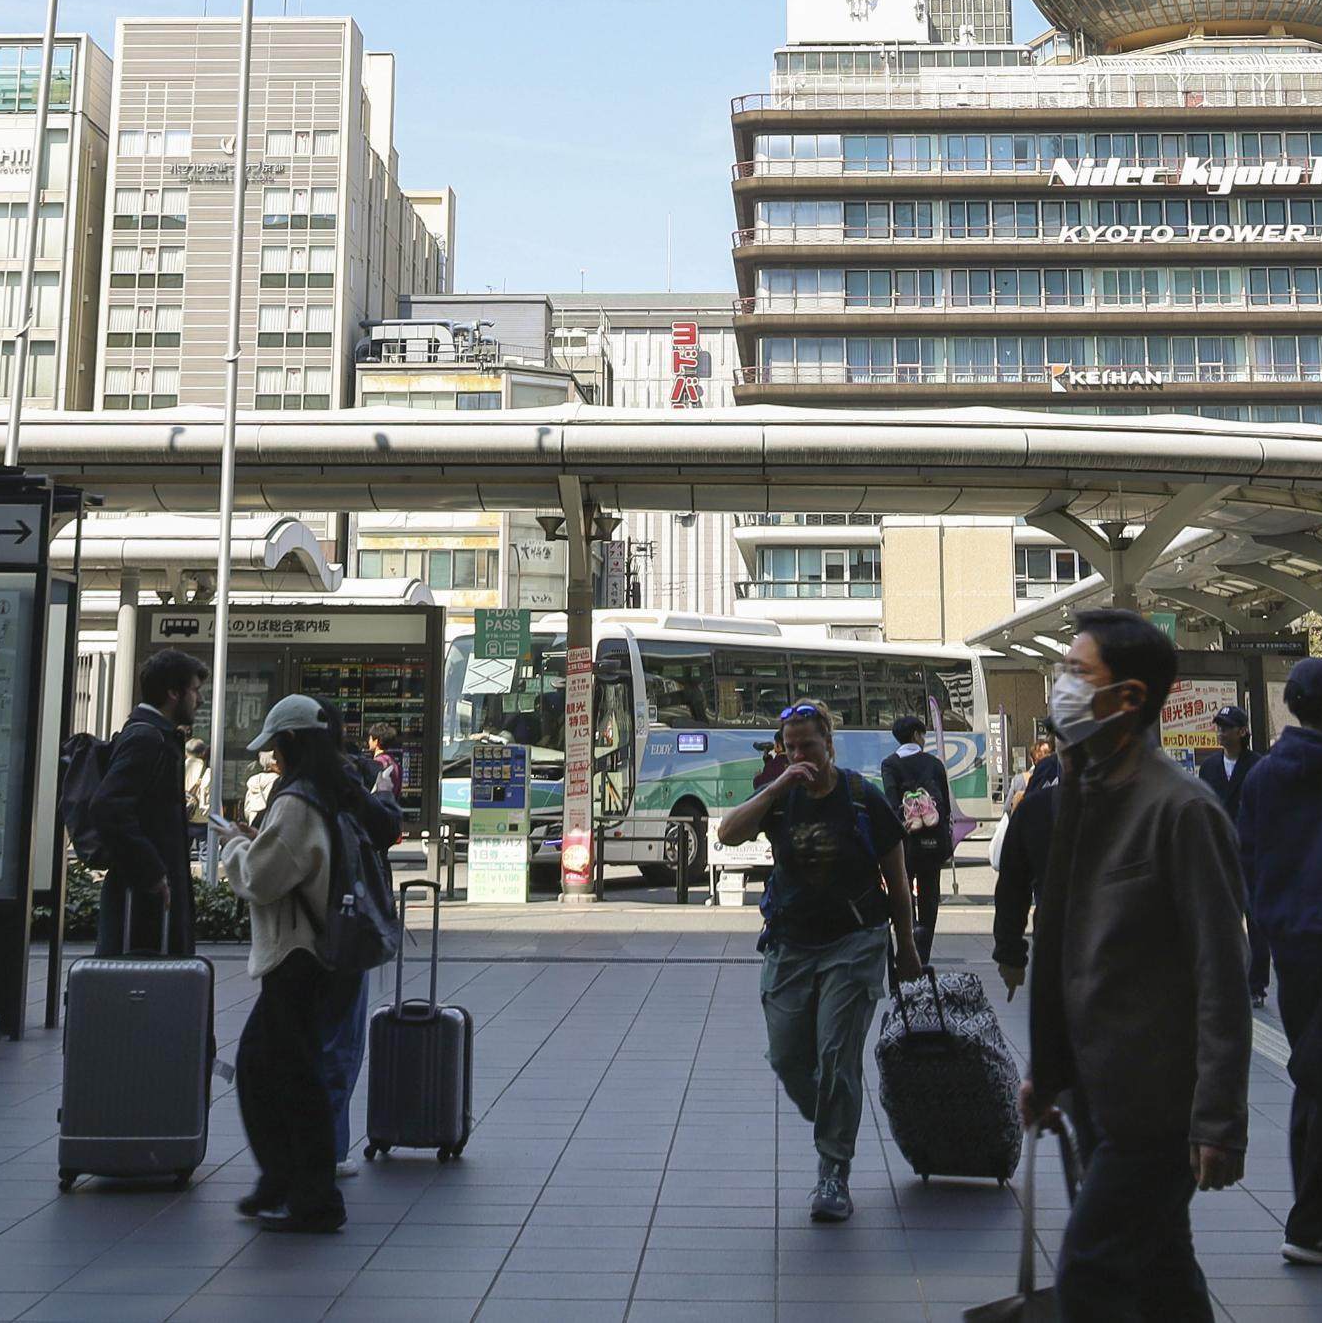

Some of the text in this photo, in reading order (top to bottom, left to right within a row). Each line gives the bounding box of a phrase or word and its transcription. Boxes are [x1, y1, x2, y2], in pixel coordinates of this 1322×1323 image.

[1048, 158, 1169, 186] Nidec
[1178, 157, 1304, 195] Kyoto
[1058, 225, 1175, 243] KYOTO
[1186, 225, 1307, 243] TOWER
[670, 321, 699, 409] ヨドバ
[1069, 369, 1162, 385] KEIHAN
[208, 619, 330, 634] のりば総合案内板
[485, 618, 522, 631] PASS
[566, 701, 587, 715] 観光
[568, 713, 589, 727] 特急
[573, 727, 591, 738] バス
